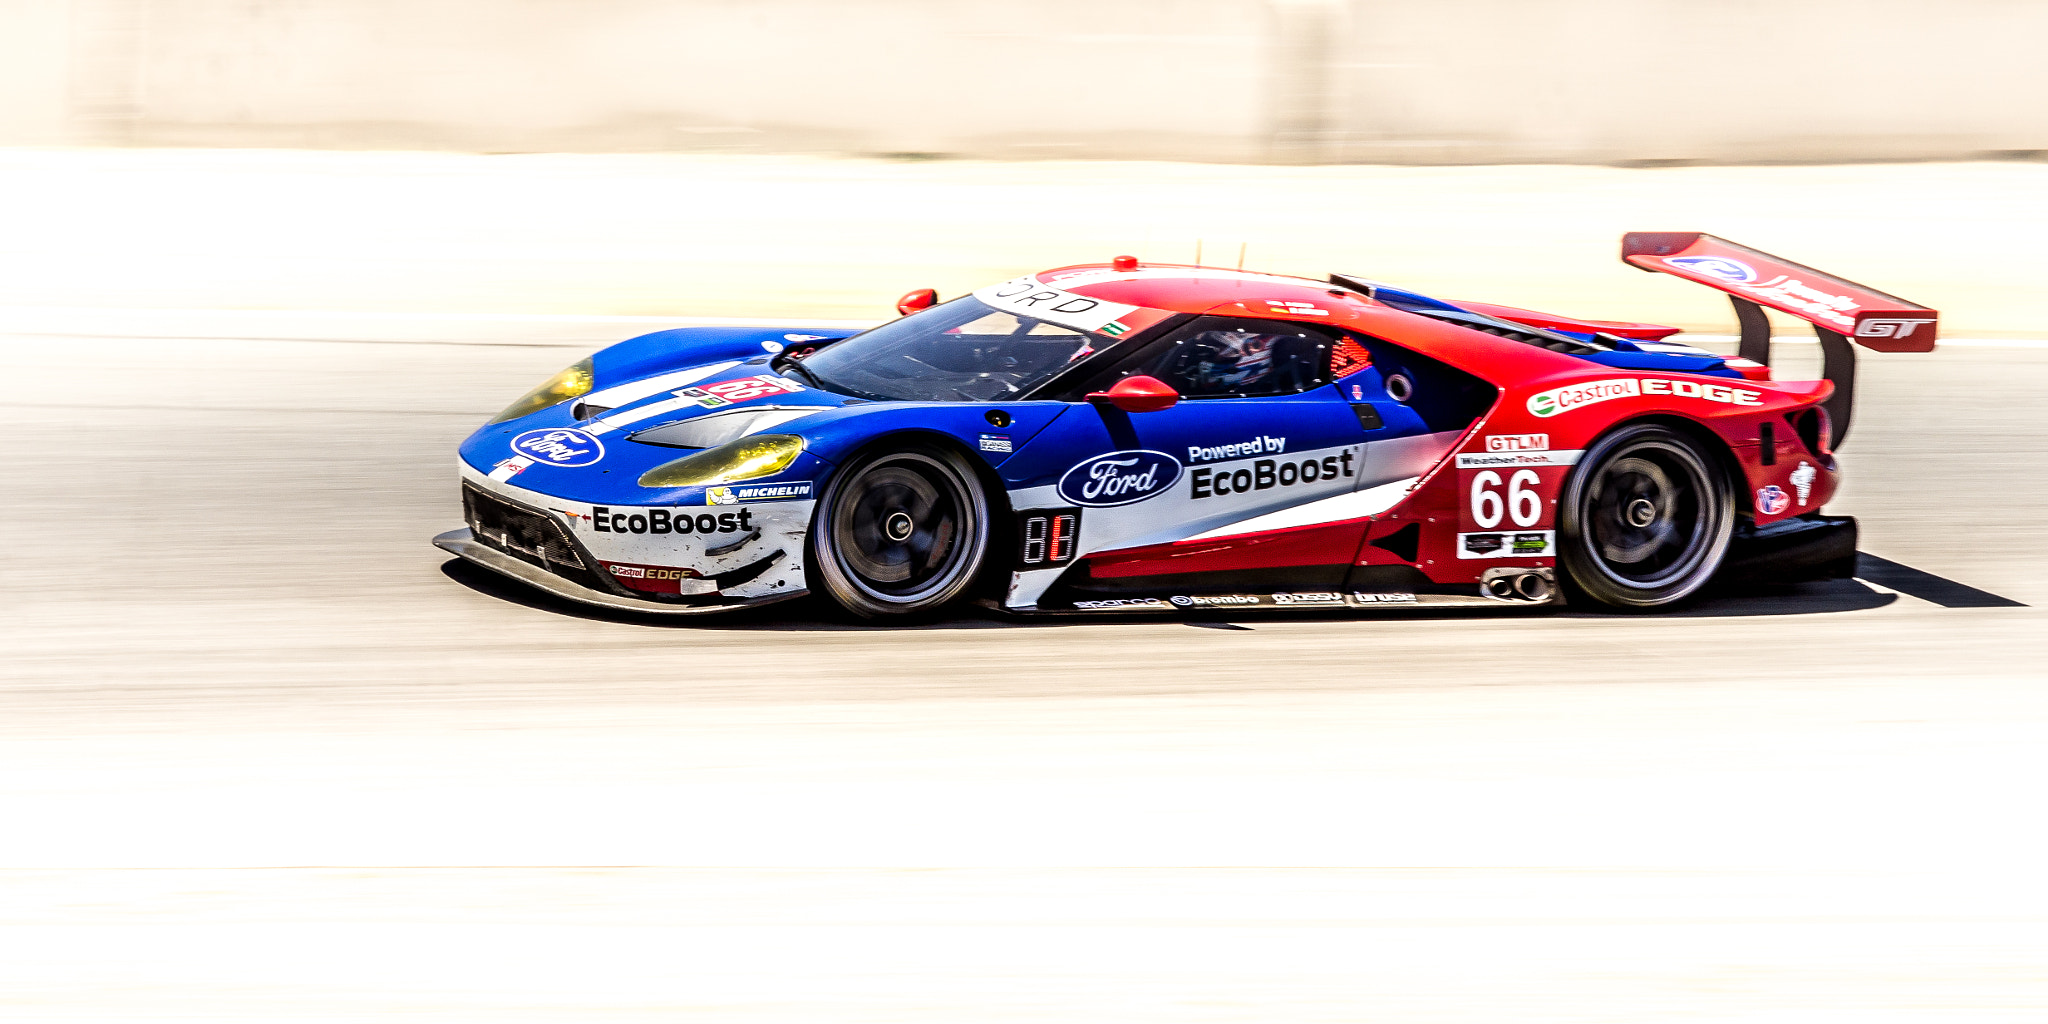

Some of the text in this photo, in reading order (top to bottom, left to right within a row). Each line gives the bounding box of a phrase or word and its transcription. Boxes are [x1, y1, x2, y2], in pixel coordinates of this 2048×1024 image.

[996, 283, 1100, 314] ORD
[1854, 318, 1938, 339] GT
[1559, 378, 1765, 408] Castrol EDGE
[519, 430, 590, 462] Ford
[1187, 435, 1286, 463] Powered by
[1490, 436, 1545, 450] GTLM
[1081, 457, 1159, 500] Ford
[1190, 449, 1355, 500] EcoBoost
[738, 485, 811, 498] MICHELIN
[1470, 469, 1543, 529] 66
[593, 507, 753, 535] EcoBoost
[617, 567, 693, 580] Castrol EDGE
[1073, 598, 1162, 608] sparco
[1190, 595, 1260, 604] brembo
